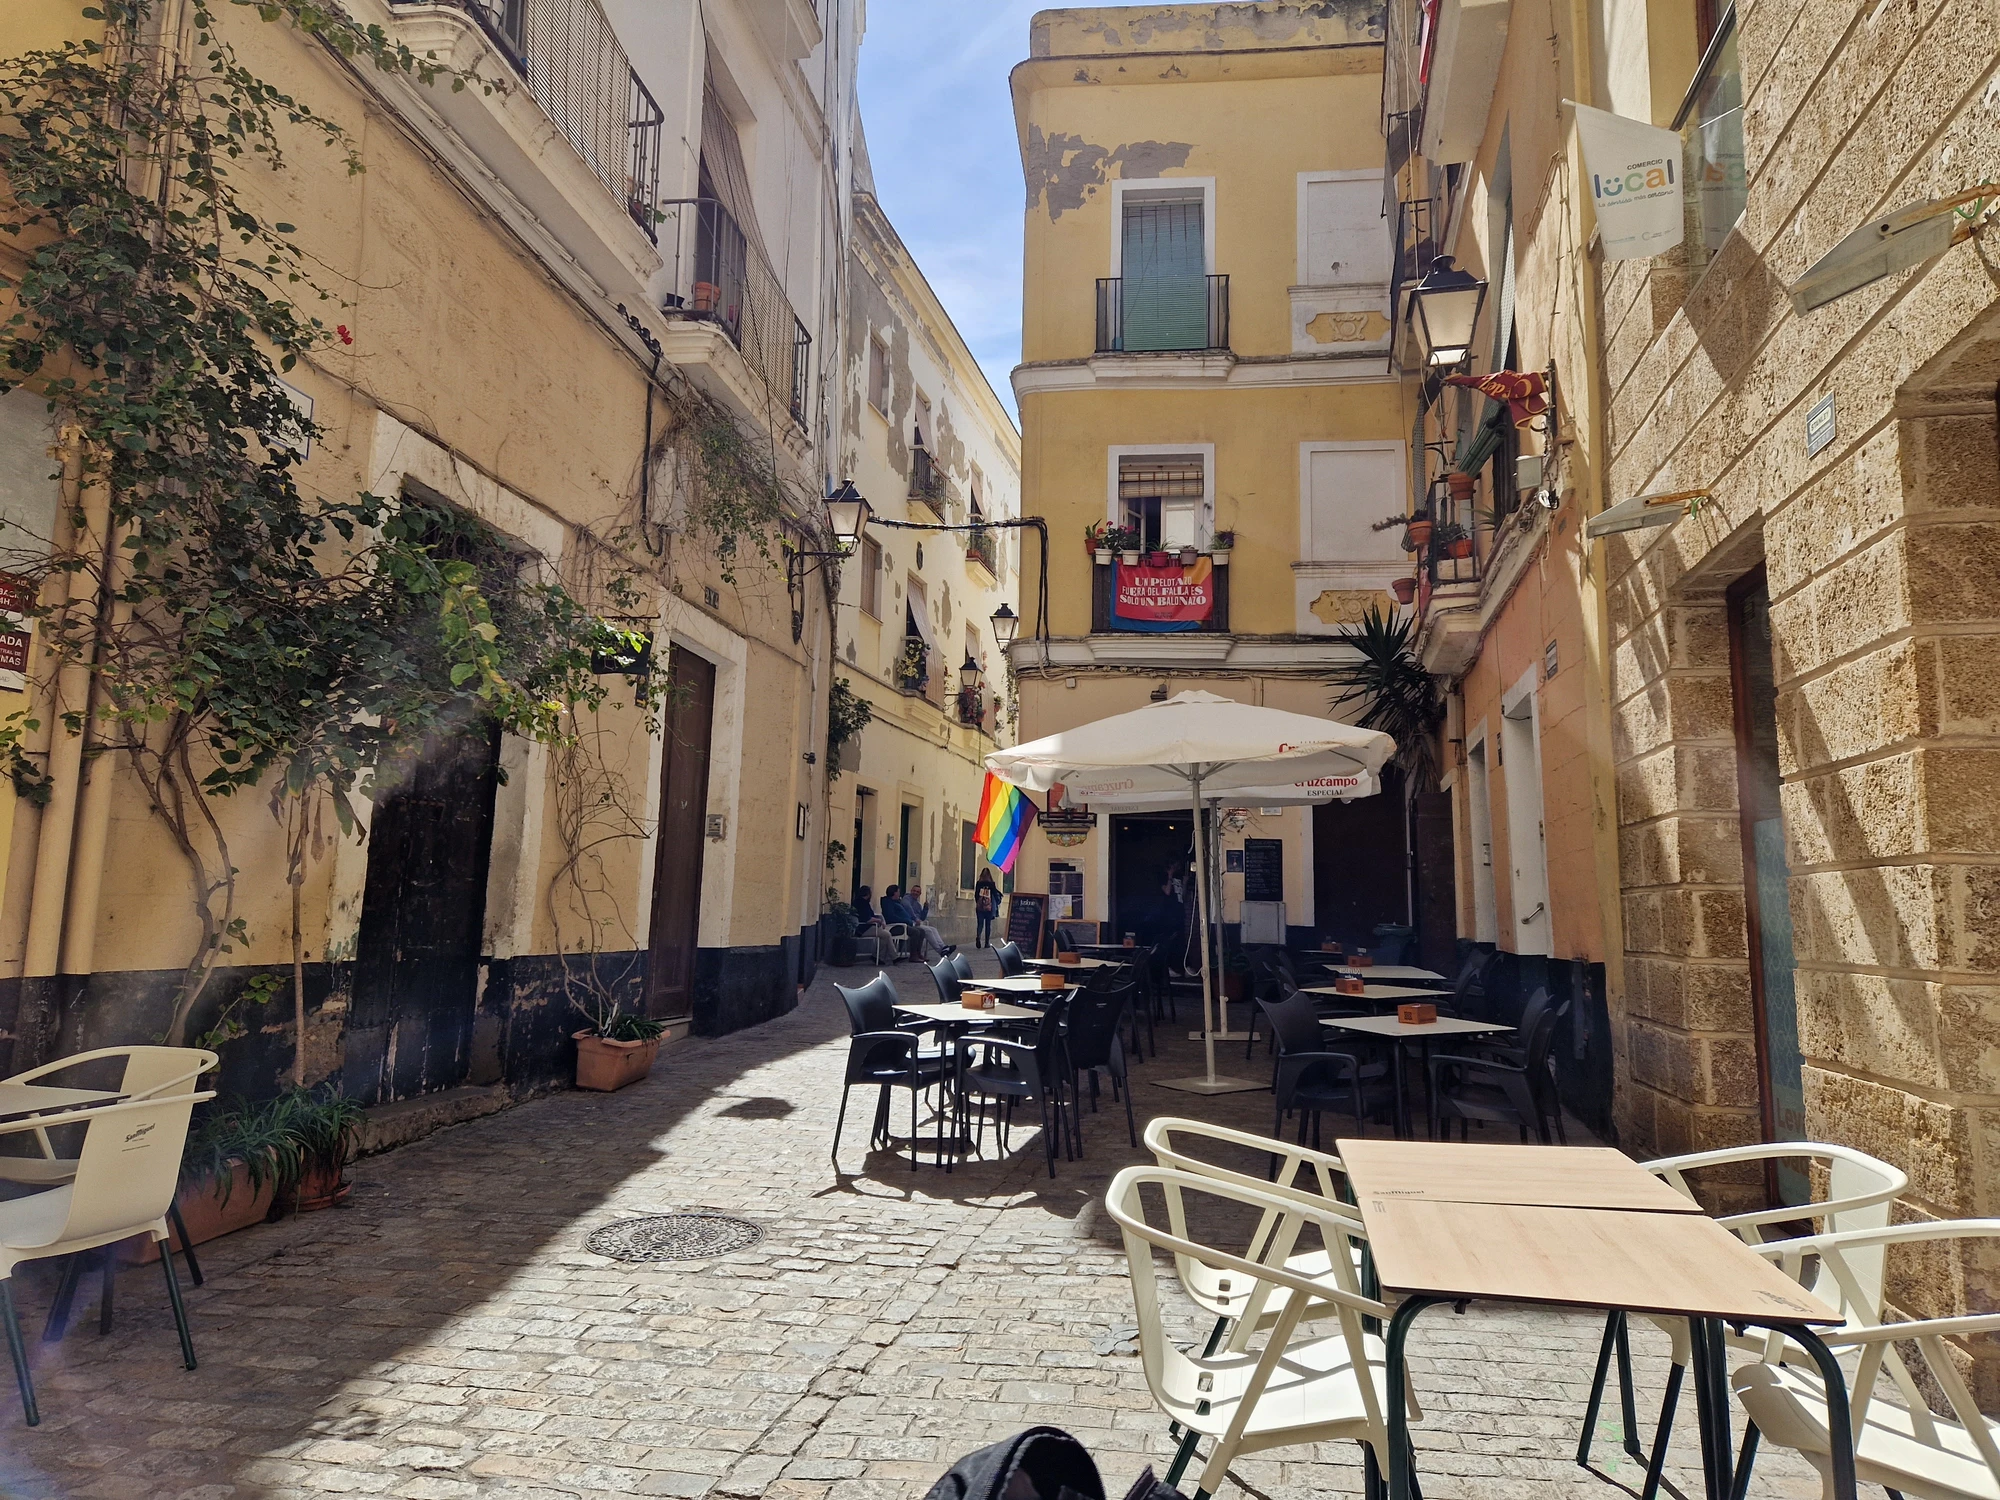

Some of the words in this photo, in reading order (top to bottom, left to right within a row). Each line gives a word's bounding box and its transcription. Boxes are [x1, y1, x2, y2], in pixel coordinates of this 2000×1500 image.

[1626, 158, 1663, 171] COMERCIO
[1150, 576, 1192, 587] PELOTAZO
[1122, 586, 1146, 596] FUERA
[1147, 587, 1161, 596] DEL
[1162, 587, 1189, 596] FALLA
[1190, 586, 1204, 596] ES
[1119, 594, 1139, 605] SOLO
[1140, 596, 1155, 606] UN
[1157, 595, 1206, 606] BALONAZO
[1307, 789, 1345, 797] ESPECIAL
